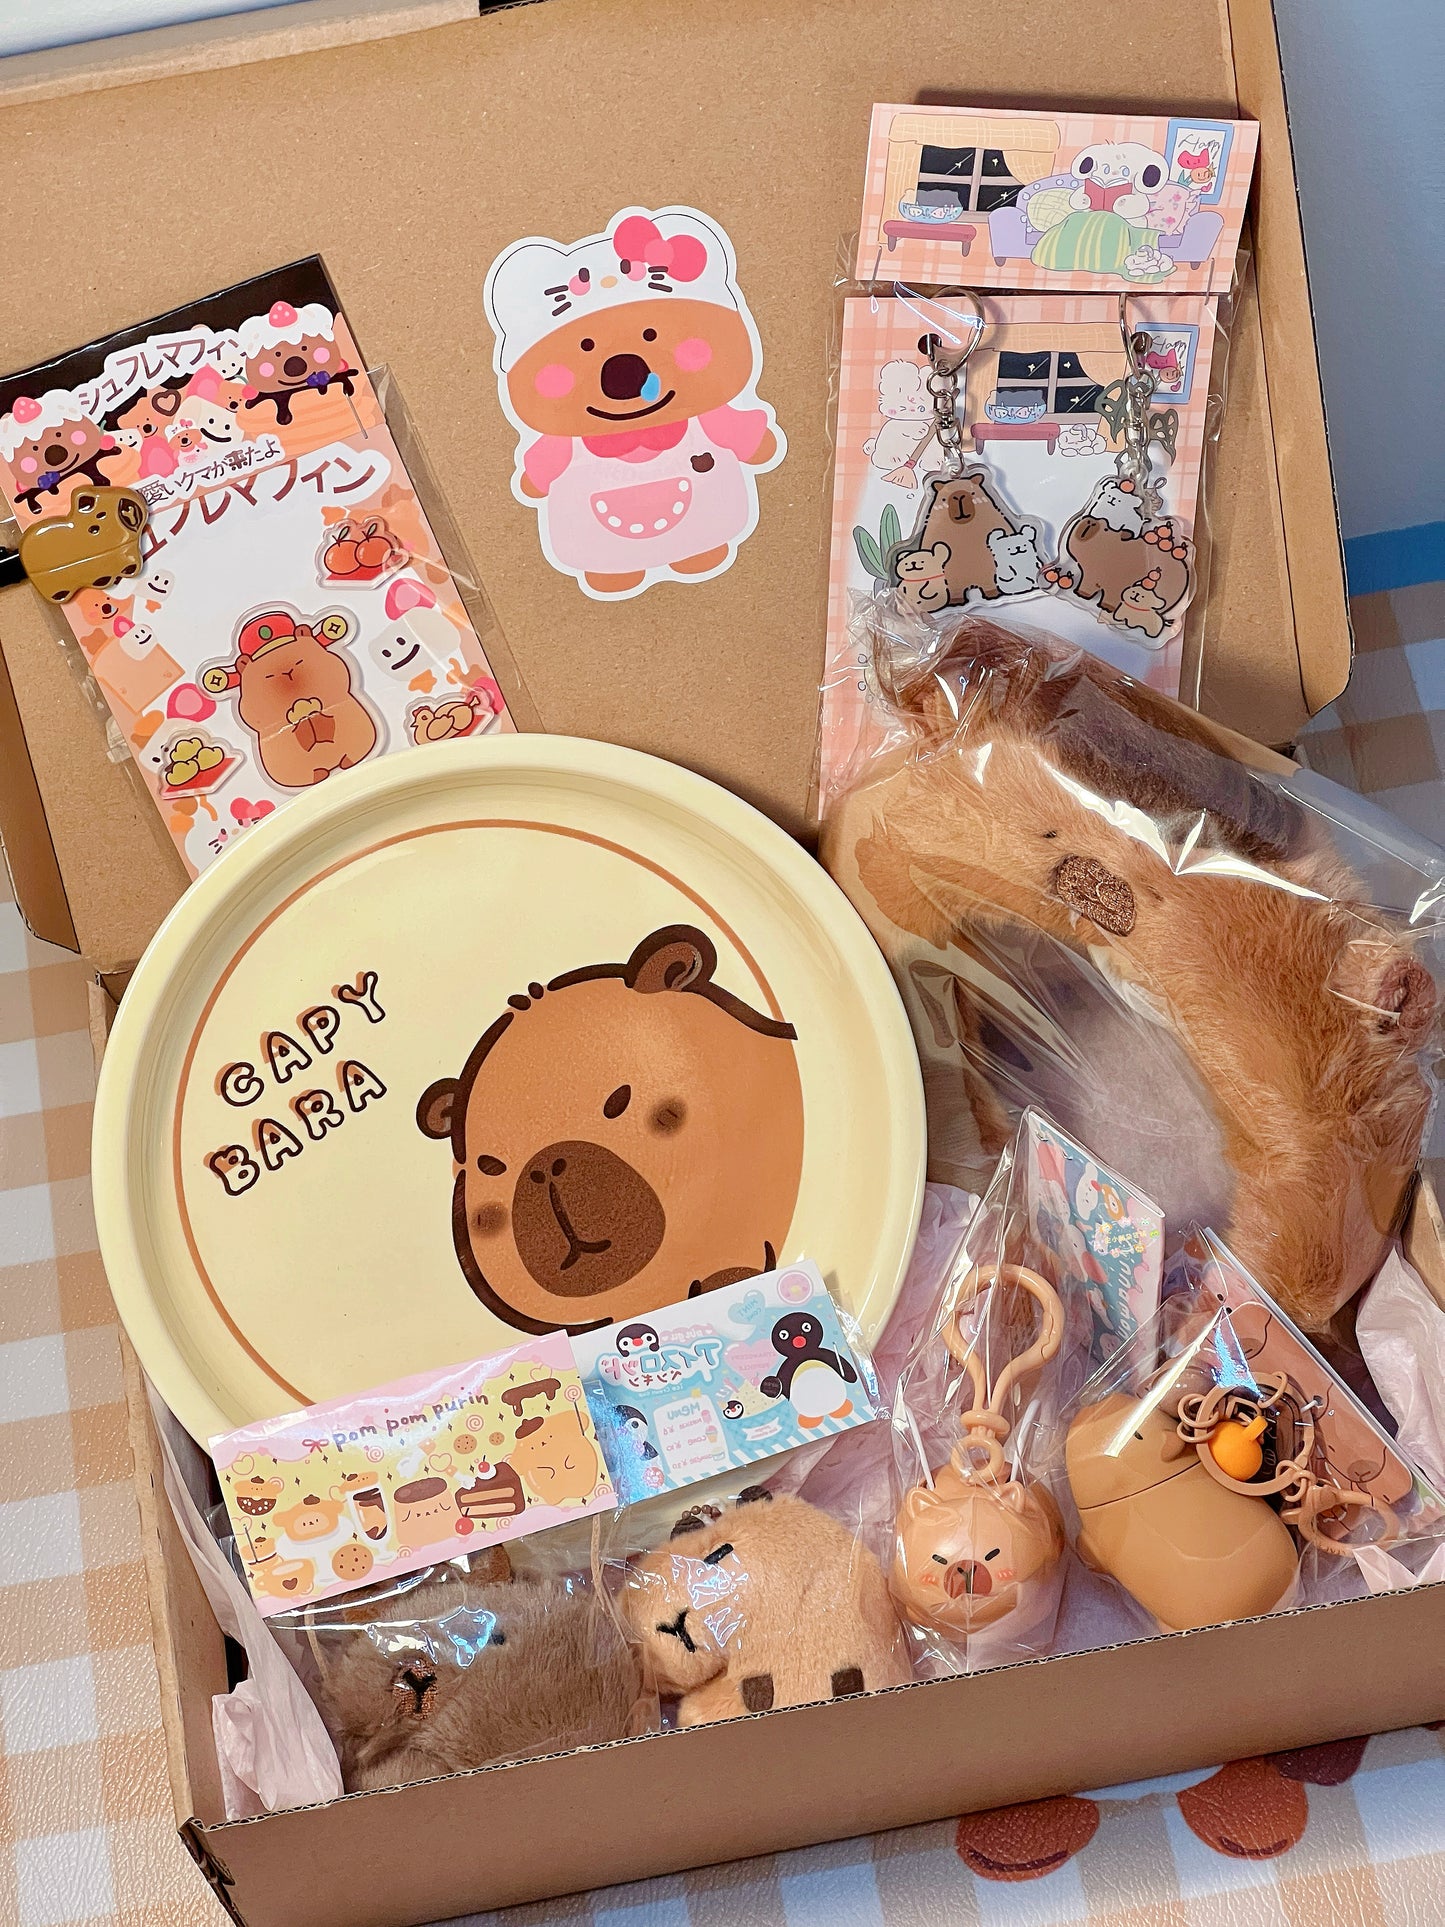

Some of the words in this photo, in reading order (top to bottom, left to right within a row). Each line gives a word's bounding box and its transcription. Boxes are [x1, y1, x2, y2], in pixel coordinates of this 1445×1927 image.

[1178, 133, 1221, 159] Happy
[1151, 335, 1188, 358] Happy
[139, 438, 281, 505] 愛いクマが来たよ
[214, 971, 386, 1107] CAPY
[203, 1059, 387, 1197] BARA
[332, 1424, 378, 1453] pom
[386, 1412, 428, 1437] pom
[432, 1392, 489, 1421] purin
